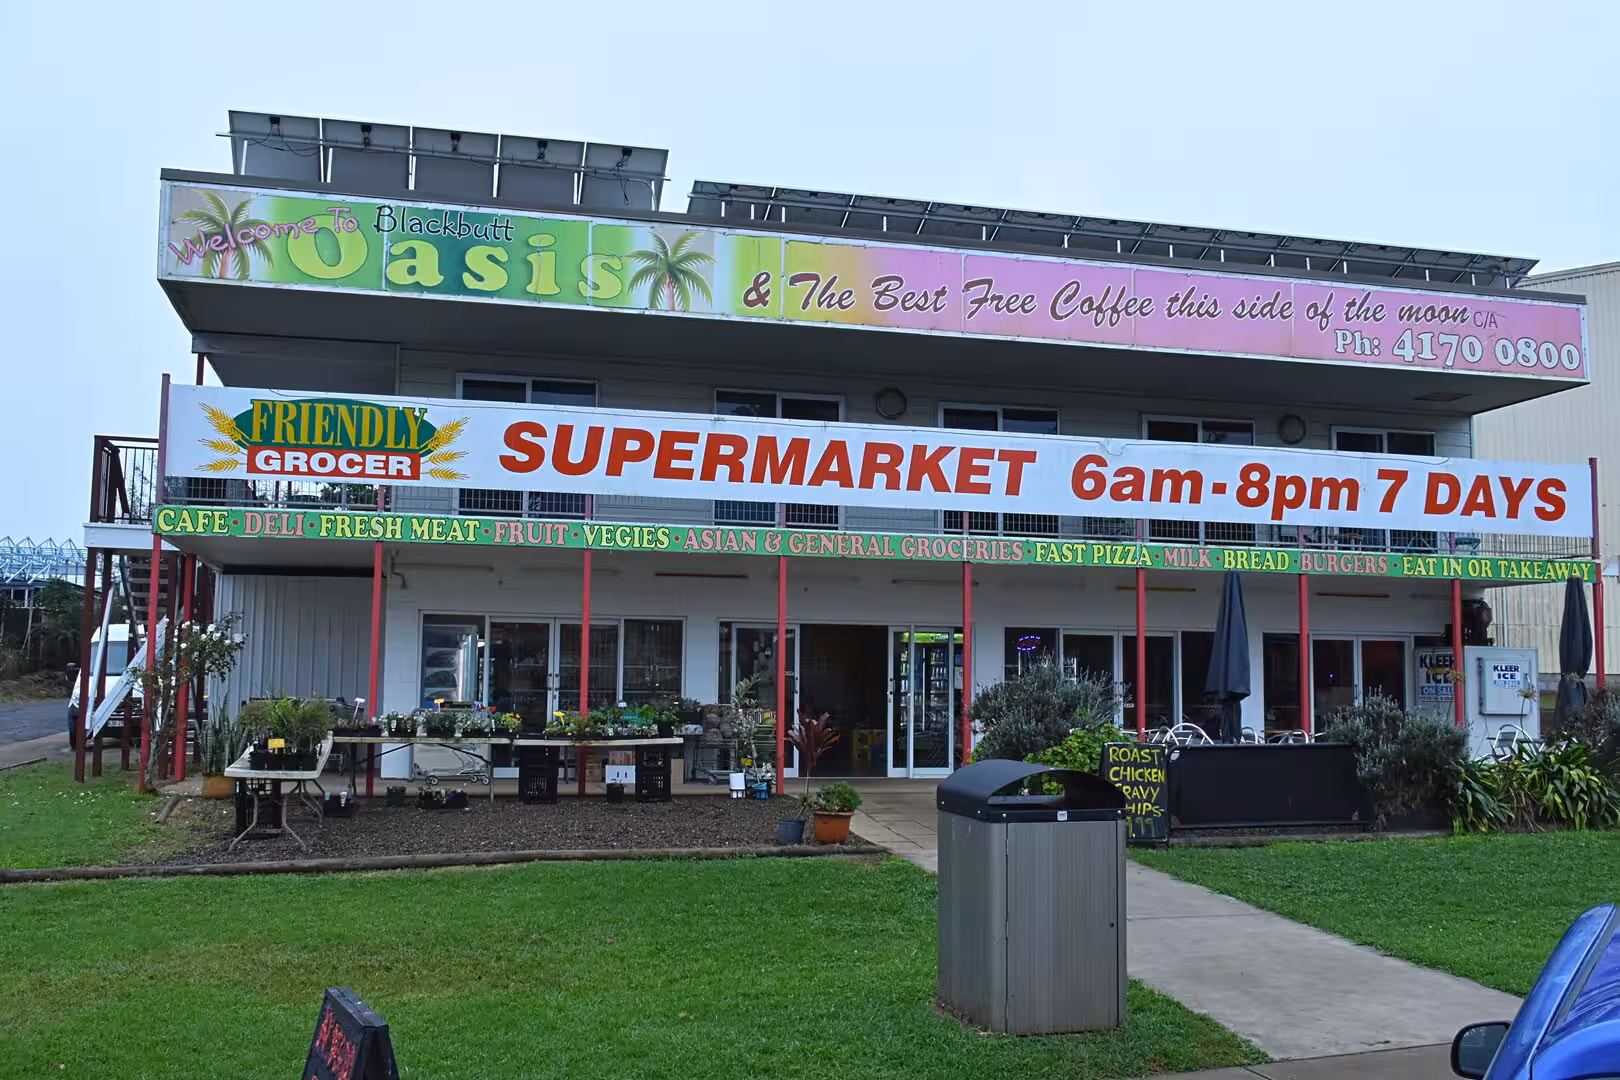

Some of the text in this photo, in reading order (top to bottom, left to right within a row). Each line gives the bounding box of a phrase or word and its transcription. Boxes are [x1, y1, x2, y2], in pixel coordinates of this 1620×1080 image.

[168, 204, 514, 266] Welcome To Blackbutt
[286, 214, 1470, 332] Oasis & The Best Free Coffee this side of the moon
[1334, 328, 1579, 370] Ph: 4170 0800
[250, 398, 428, 449] FRIENDLY
[255, 449, 412, 476] GROCER
[499, 421, 1037, 496] SUPERMARKET
[1376, 468, 1409, 514] 7
[1424, 471, 1568, 522] DAYS
[157, 508, 1592, 581] CAFE DELI FRESH MEAT FRUIT VEGIES ASIAN & GENERAL GROCERIES FAST PIZZA MILK BREAD BURGERS EAT IN OR TAKEAWAY
[1493, 664, 1520, 672] KLEER
[1423, 686, 1436, 695] ON
[1109, 747, 1161, 765] ROAST
[1109, 766, 1165, 783] CHICKEN
[1115, 783, 1160, 803] RAVY
